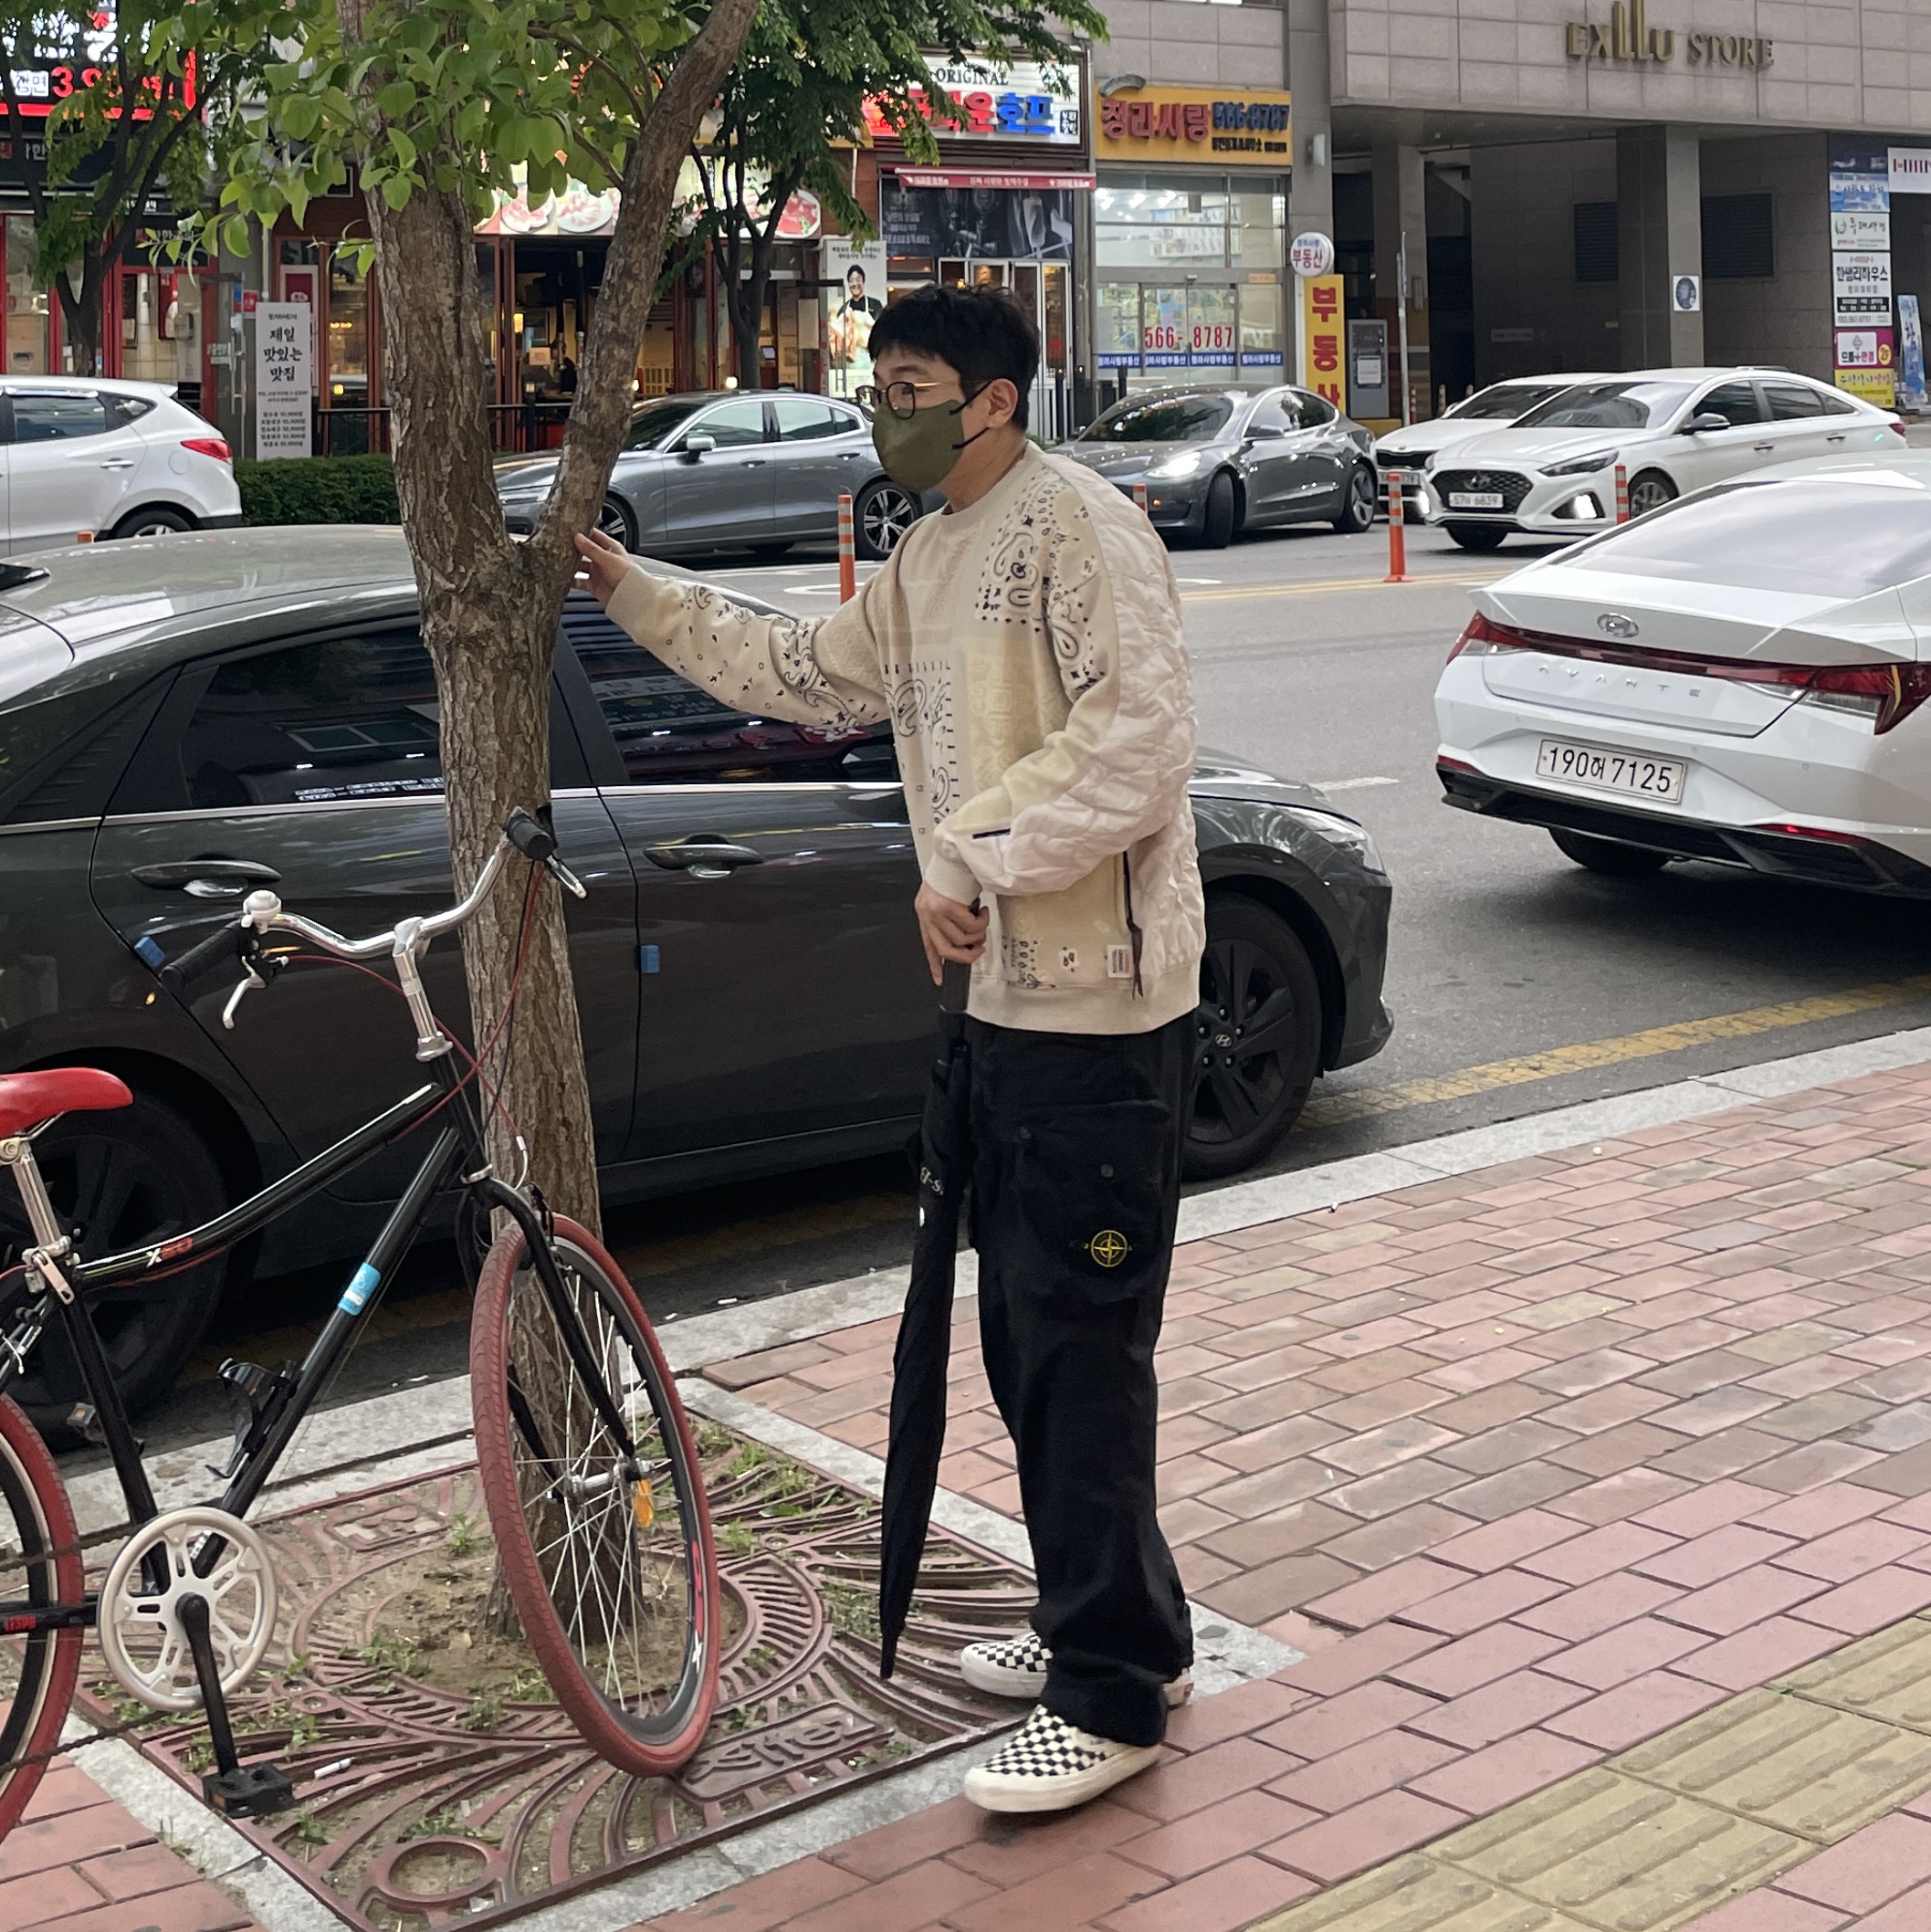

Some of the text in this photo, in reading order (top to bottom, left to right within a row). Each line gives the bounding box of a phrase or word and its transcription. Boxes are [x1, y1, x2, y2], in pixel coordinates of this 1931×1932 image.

[1689, 33, 1774, 68] STORE
[936, 67, 1009, 86] ORIGINAL
[1212, 102, 1290, 131] 566-8787
[1292, 248, 1323, 268] 부동산
[269, 326, 295, 342] 제일
[1193, 326, 1233, 349] 8787
[263, 346, 303, 362] 맛있는
[269, 365, 295, 382] 맛집
[1538, 664, 1701, 698] AVANTE
